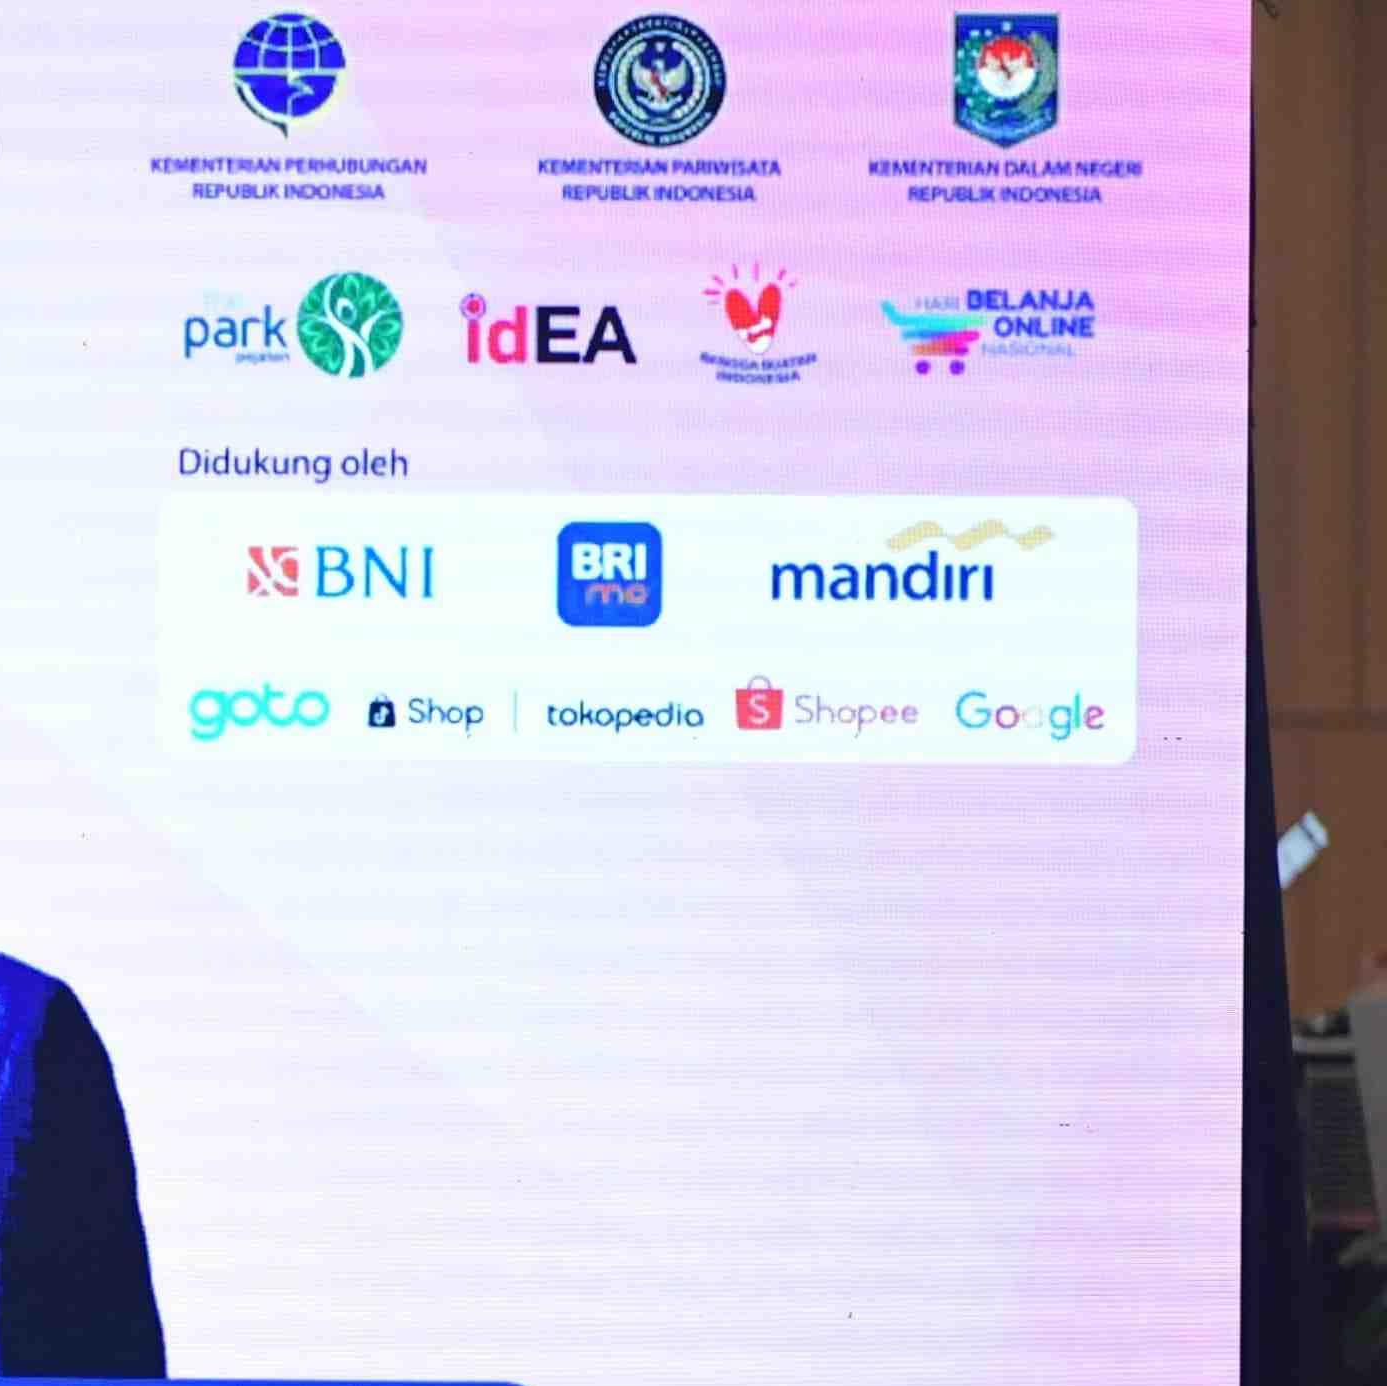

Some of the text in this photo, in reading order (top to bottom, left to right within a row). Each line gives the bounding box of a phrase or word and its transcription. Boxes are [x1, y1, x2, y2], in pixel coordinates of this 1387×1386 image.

[150, 157, 427, 174] KEMENTERIAN PERHUBUNGAN
[538, 158, 782, 176] KEMENTERIAN PARIWISATA
[869, 160, 1143, 177] KEMENTERIAN DALAM NEGERI
[192, 183, 386, 200] REPUBLIK INDONESIA
[562, 184, 756, 201] REPUBLIK INDONESIA
[908, 185, 1102, 201] REPUBLIK INDONESIA
[966, 289, 1095, 311] BELANJA
[184, 304, 288, 359] park
[460, 293, 637, 364] idEA
[993, 316, 1095, 338] ONLINE
[179, 447, 409, 484] Didukung oleh
[316, 545, 434, 598] BNI
[571, 542, 647, 581] BRI
[772, 550, 993, 600] mandiri
[189, 680, 330, 742] goto
[408, 697, 485, 732] Shop
[547, 699, 705, 733] tokopedia
[795, 694, 919, 736] Shopee
[955, 689, 1105, 741] Google
